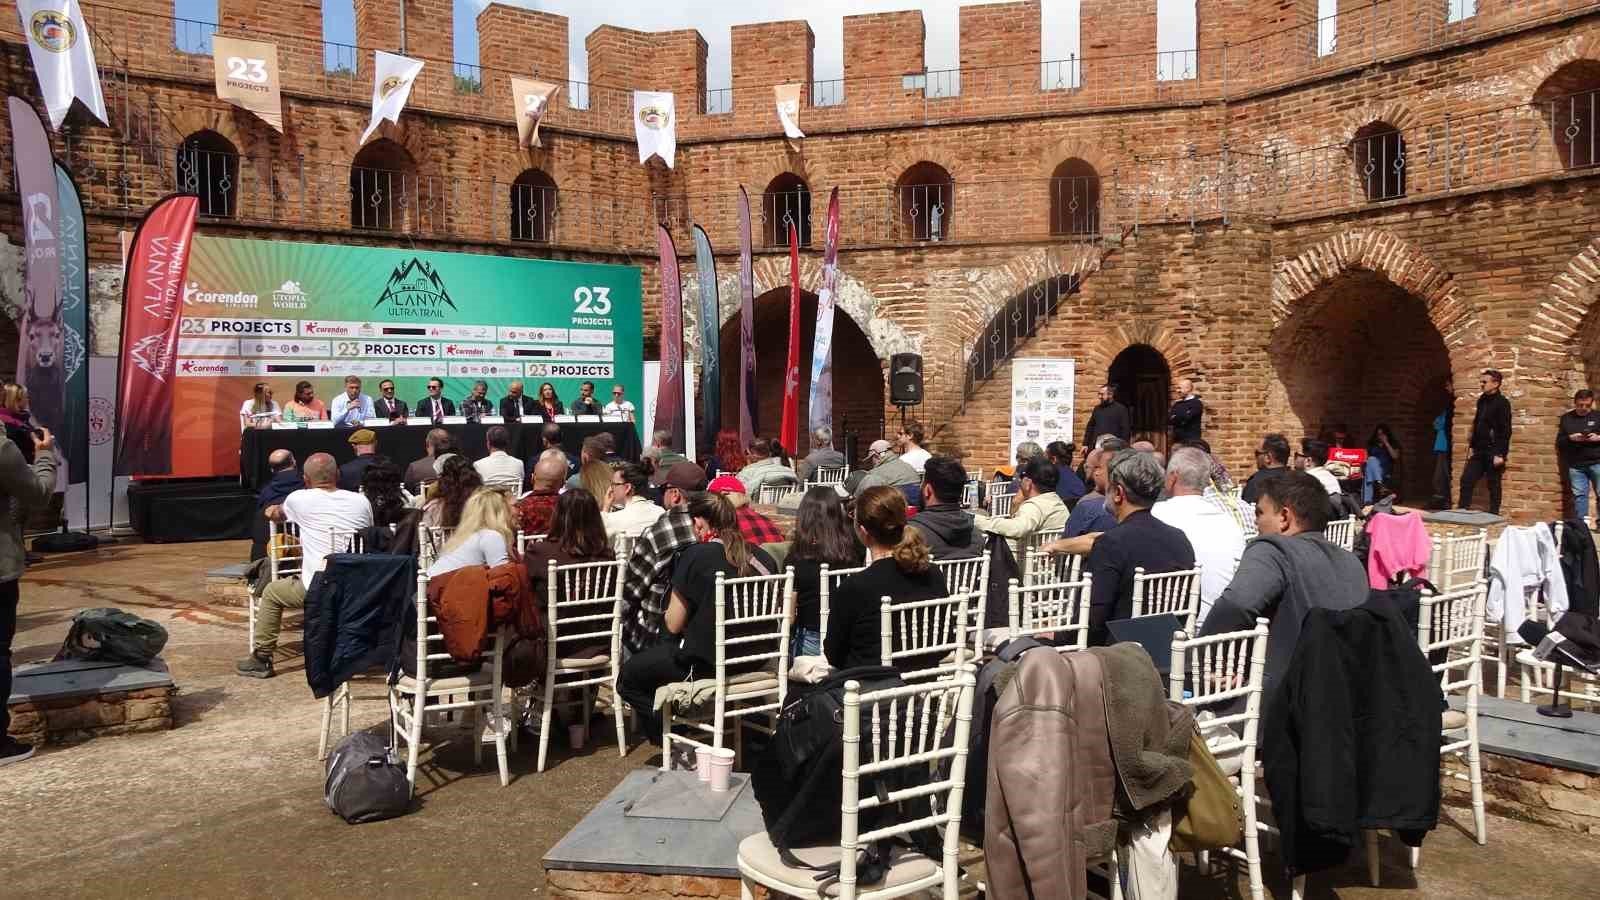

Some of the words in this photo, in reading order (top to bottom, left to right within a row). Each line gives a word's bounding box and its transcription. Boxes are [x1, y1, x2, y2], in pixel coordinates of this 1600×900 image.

[227, 56, 268, 83] 23
[226, 79, 270, 92] PROJECTS
[168, 239, 184, 275] TRAIL
[143, 236, 168, 318] ALANYA
[196, 291, 258, 304] corendon
[573, 286, 612, 315] 23
[272, 301, 307, 309] WORLD
[388, 307, 418, 317] ULTRA
[420, 308, 444, 318] TRAIL
[181, 318, 206, 334] 23
[211, 320, 293, 334] PROJECTS
[571, 317, 613, 326] PROJECTS
[337, 341, 360, 356] 23
[365, 343, 436, 356] PROJECTS
[529, 363, 548, 377] 23
[551, 365, 610, 377] PROJECTS
